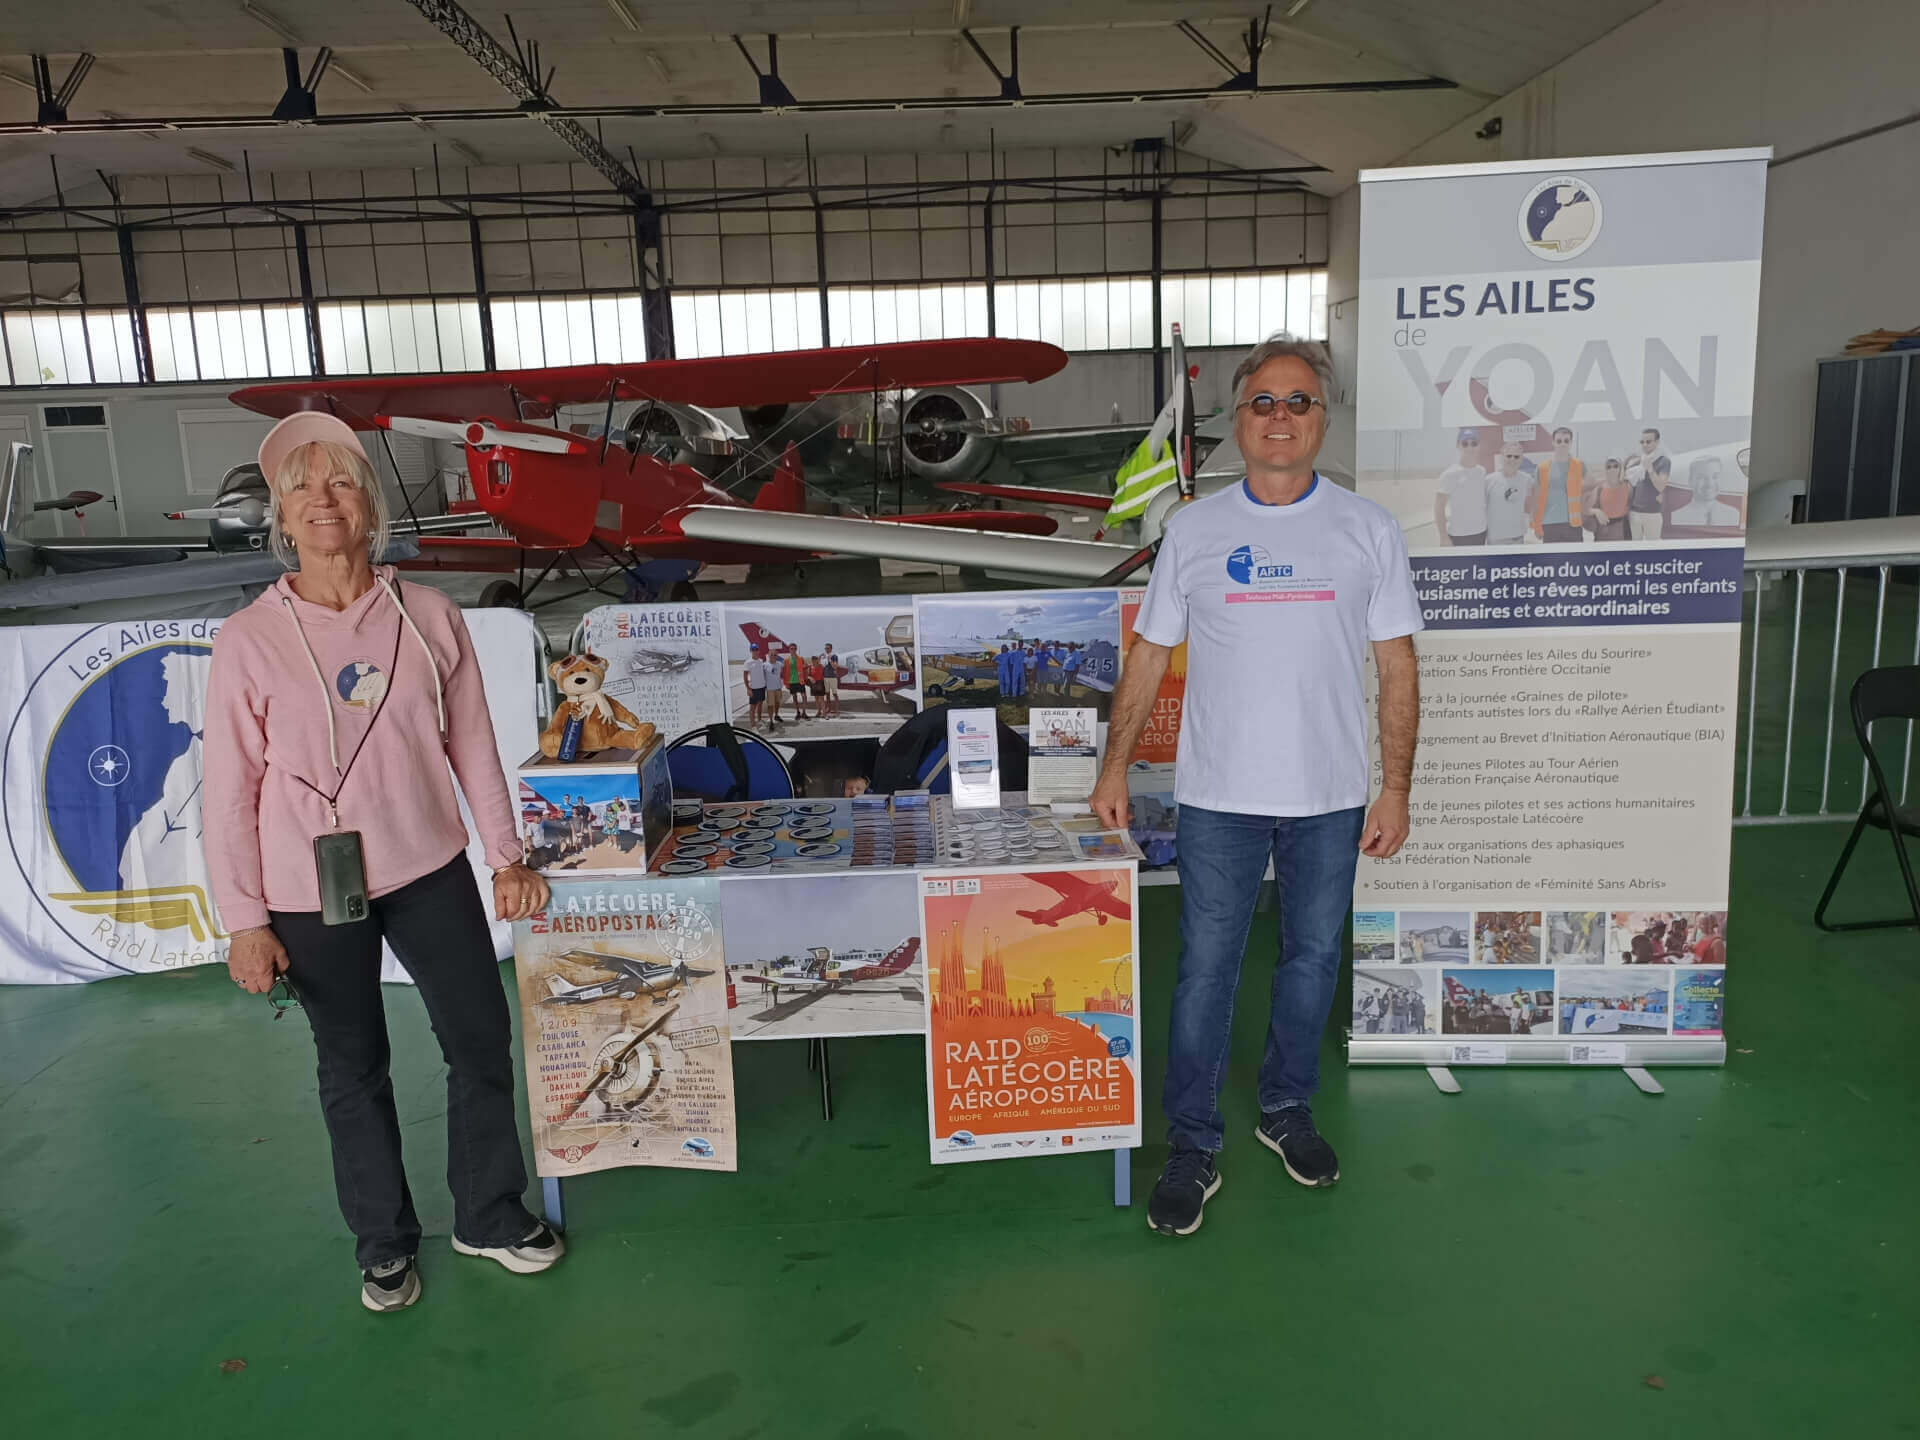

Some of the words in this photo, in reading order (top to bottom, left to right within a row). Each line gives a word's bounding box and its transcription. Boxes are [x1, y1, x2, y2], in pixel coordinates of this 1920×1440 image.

[1396, 284, 1465, 320] LES
[1475, 277, 1595, 316] AILES
[1393, 322, 1427, 347] de
[1396, 335, 1719, 430] YOAN
[1259, 567, 1291, 577] ARTC
[1473, 564, 1487, 580] la
[1490, 562, 1555, 582] passion
[1558, 561, 1580, 577] du
[1584, 560, 1610, 576] vol
[1613, 561, 1631, 576] et
[1634, 558, 1703, 575] susciter
[1416, 585, 1488, 601] usiasme
[1492, 585, 1509, 598] et
[1513, 583, 1535, 598] les
[1539, 582, 1588, 598] rêves
[1592, 580, 1641, 599] parmi
[1645, 579, 1668, 594] les
[1671, 578, 1737, 594] enfants
[1423, 604, 1511, 620] ordinaires
[1513, 603, 1531, 618] et
[1534, 600, 1670, 618] extraordinaires
[68, 647, 113, 681] Les
[120, 619, 181, 652] Ailes
[191, 618, 221, 640] de
[1436, 655, 1458, 663] aux
[1526, 650, 1543, 661] les
[1546, 649, 1577, 660] Ailes
[1581, 648, 1597, 660] du
[1418, 666, 1455, 678] iation
[1459, 666, 1488, 678] Sans
[1492, 665, 1547, 676] Frontière
[1551, 663, 1611, 675] Occitanie
[1446, 692, 1457, 703] la
[1460, 692, 1507, 705] journée
[1568, 690, 1583, 701] de
[1477, 707, 1524, 718] autistes
[1528, 706, 1551, 717] lors
[1555, 705, 1571, 716] du
[1621, 704, 1662, 715] Aérien
[1042, 718, 1086, 730] YOAN
[1482, 735, 1497, 744] au
[1500, 732, 1537, 744] Brevet
[1541, 731, 1606, 743] d'Initiation
[1609, 730, 1691, 743] Aéronautique
[1695, 729, 1725, 742] (BIA)
[1423, 759, 1439, 770] de
[1442, 760, 1481, 772] jeunes
[1485, 759, 1525, 770] Pilotes
[1529, 761, 1544, 769] au
[1547, 758, 1576, 769] Tour
[1578, 757, 1619, 769] Aérien
[1412, 774, 1471, 785] édération
[1475, 774, 1530, 786] Française
[1534, 773, 1619, 785] Aéronautique
[1423, 800, 1438, 811] de
[1441, 800, 1481, 812] jeunes
[1484, 799, 1524, 812] pilotes
[1528, 800, 1540, 810] et
[1543, 801, 1564, 810] ses
[1567, 798, 1611, 810] actions
[1615, 797, 1695, 809] humanitaires
[1523, 813, 1584, 824] Latécoère
[1422, 841, 1444, 850] aux
[1447, 840, 1528, 852] organisations
[1531, 839, 1553, 850] des
[1556, 839, 1625, 851] aphasiques
[1405, 853, 1470, 865] Fédération
[1473, 853, 1532, 864] Nationale
[1373, 879, 1420, 890] Soutien
[1433, 878, 1512, 892] l'organisation
[1515, 878, 1531, 889] de
[1597, 878, 1626, 890] Sans
[552, 889, 677, 914] LATÉCOÈRE
[91, 918, 146, 960] Raid
[668, 925, 702, 941] 2020
[541, 1030, 580, 1042] TOULOUSE
[1026, 1033, 1049, 1047] 100
[536, 1040, 586, 1053] CASABLANCA
[945, 1037, 1022, 1064] RAID
[946, 1055, 1120, 1090] LATÉCOÈRE
[949, 1082, 1121, 1111] AÉROPOSTALE
[949, 1113, 983, 1122] EUROPE
[993, 1109, 1030, 1119] AFRIQUE
[1040, 1105, 1084, 1116] AMÉRIQUE
[1087, 1105, 1100, 1113] DU
[1103, 1103, 1121, 1112] SUD
